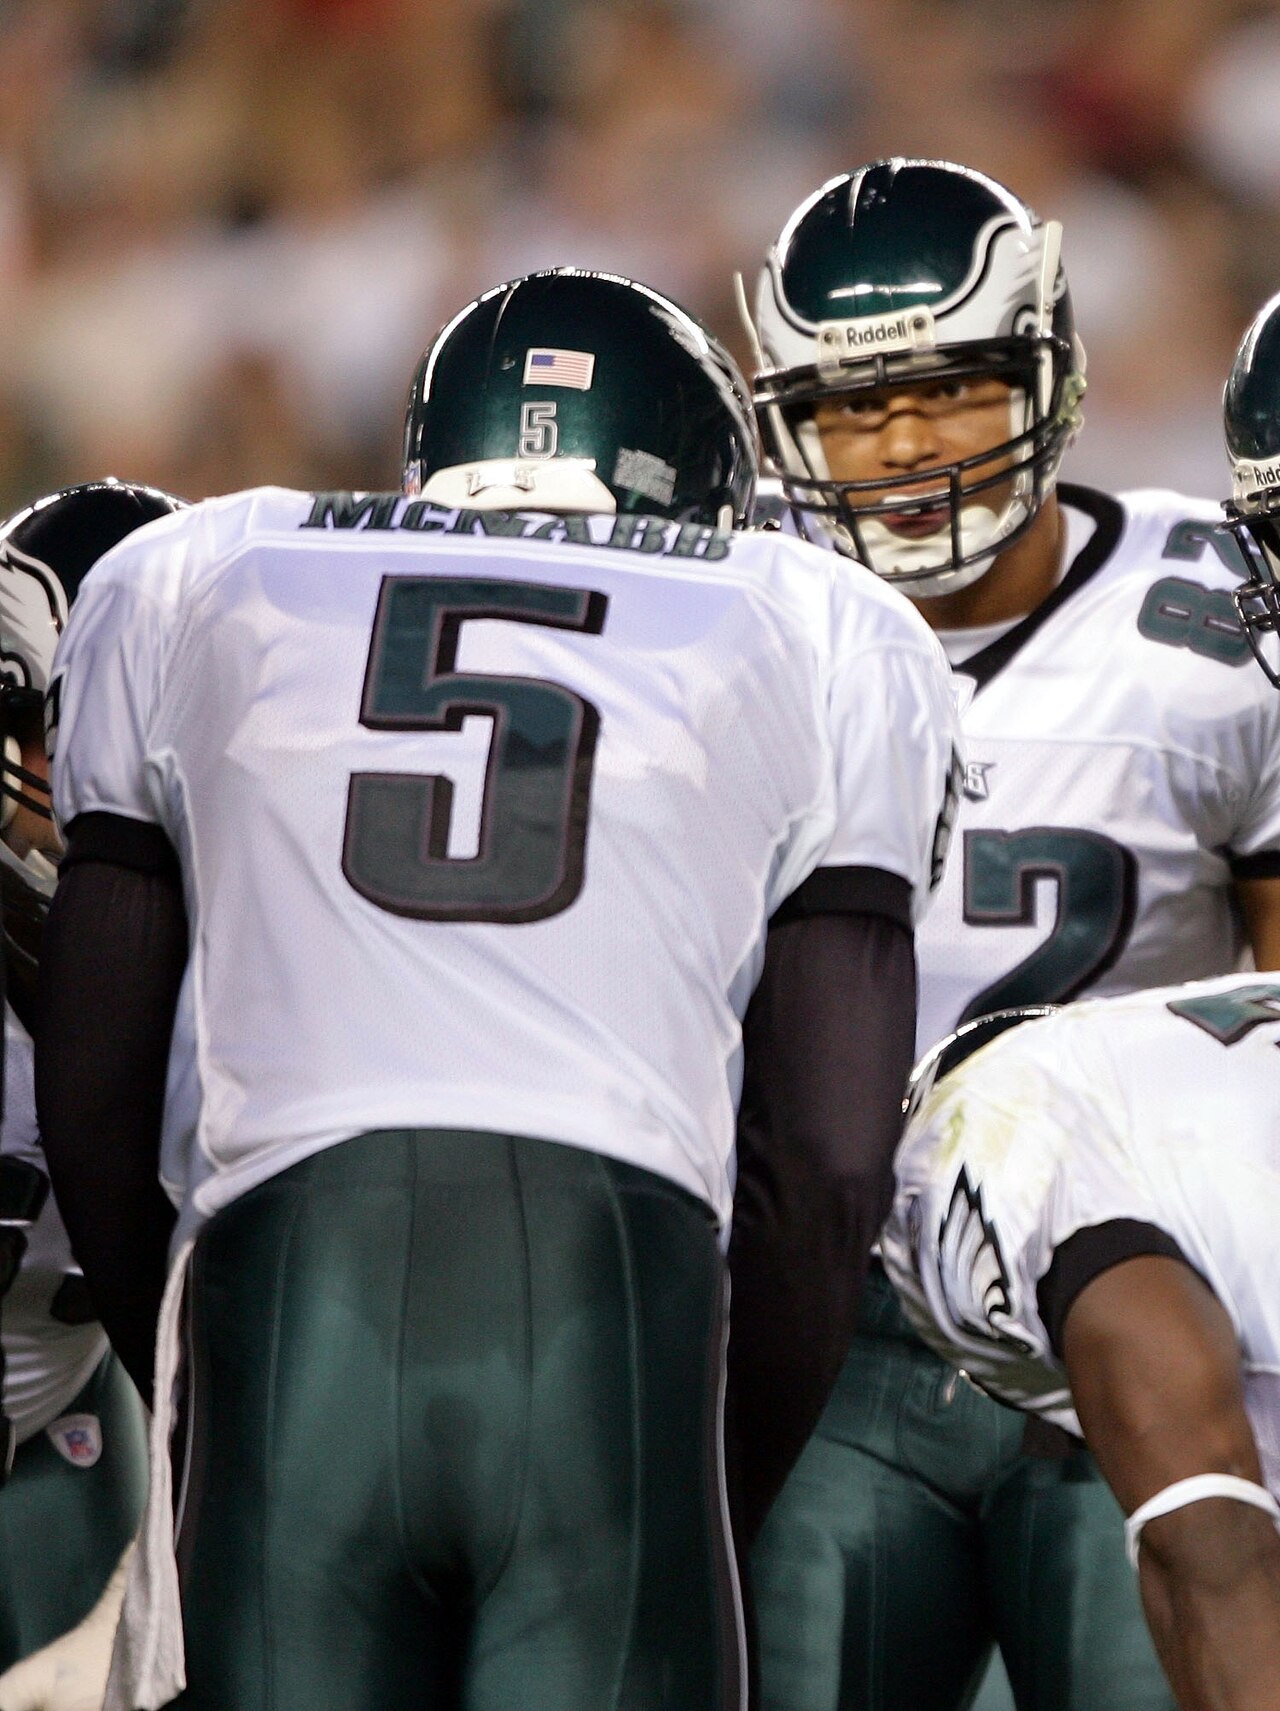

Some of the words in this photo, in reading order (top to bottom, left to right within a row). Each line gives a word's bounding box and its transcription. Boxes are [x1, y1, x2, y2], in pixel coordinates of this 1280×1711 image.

[845, 319, 908, 347] Riddell
[518, 400, 559, 460] 5
[341, 574, 610, 924] 5
